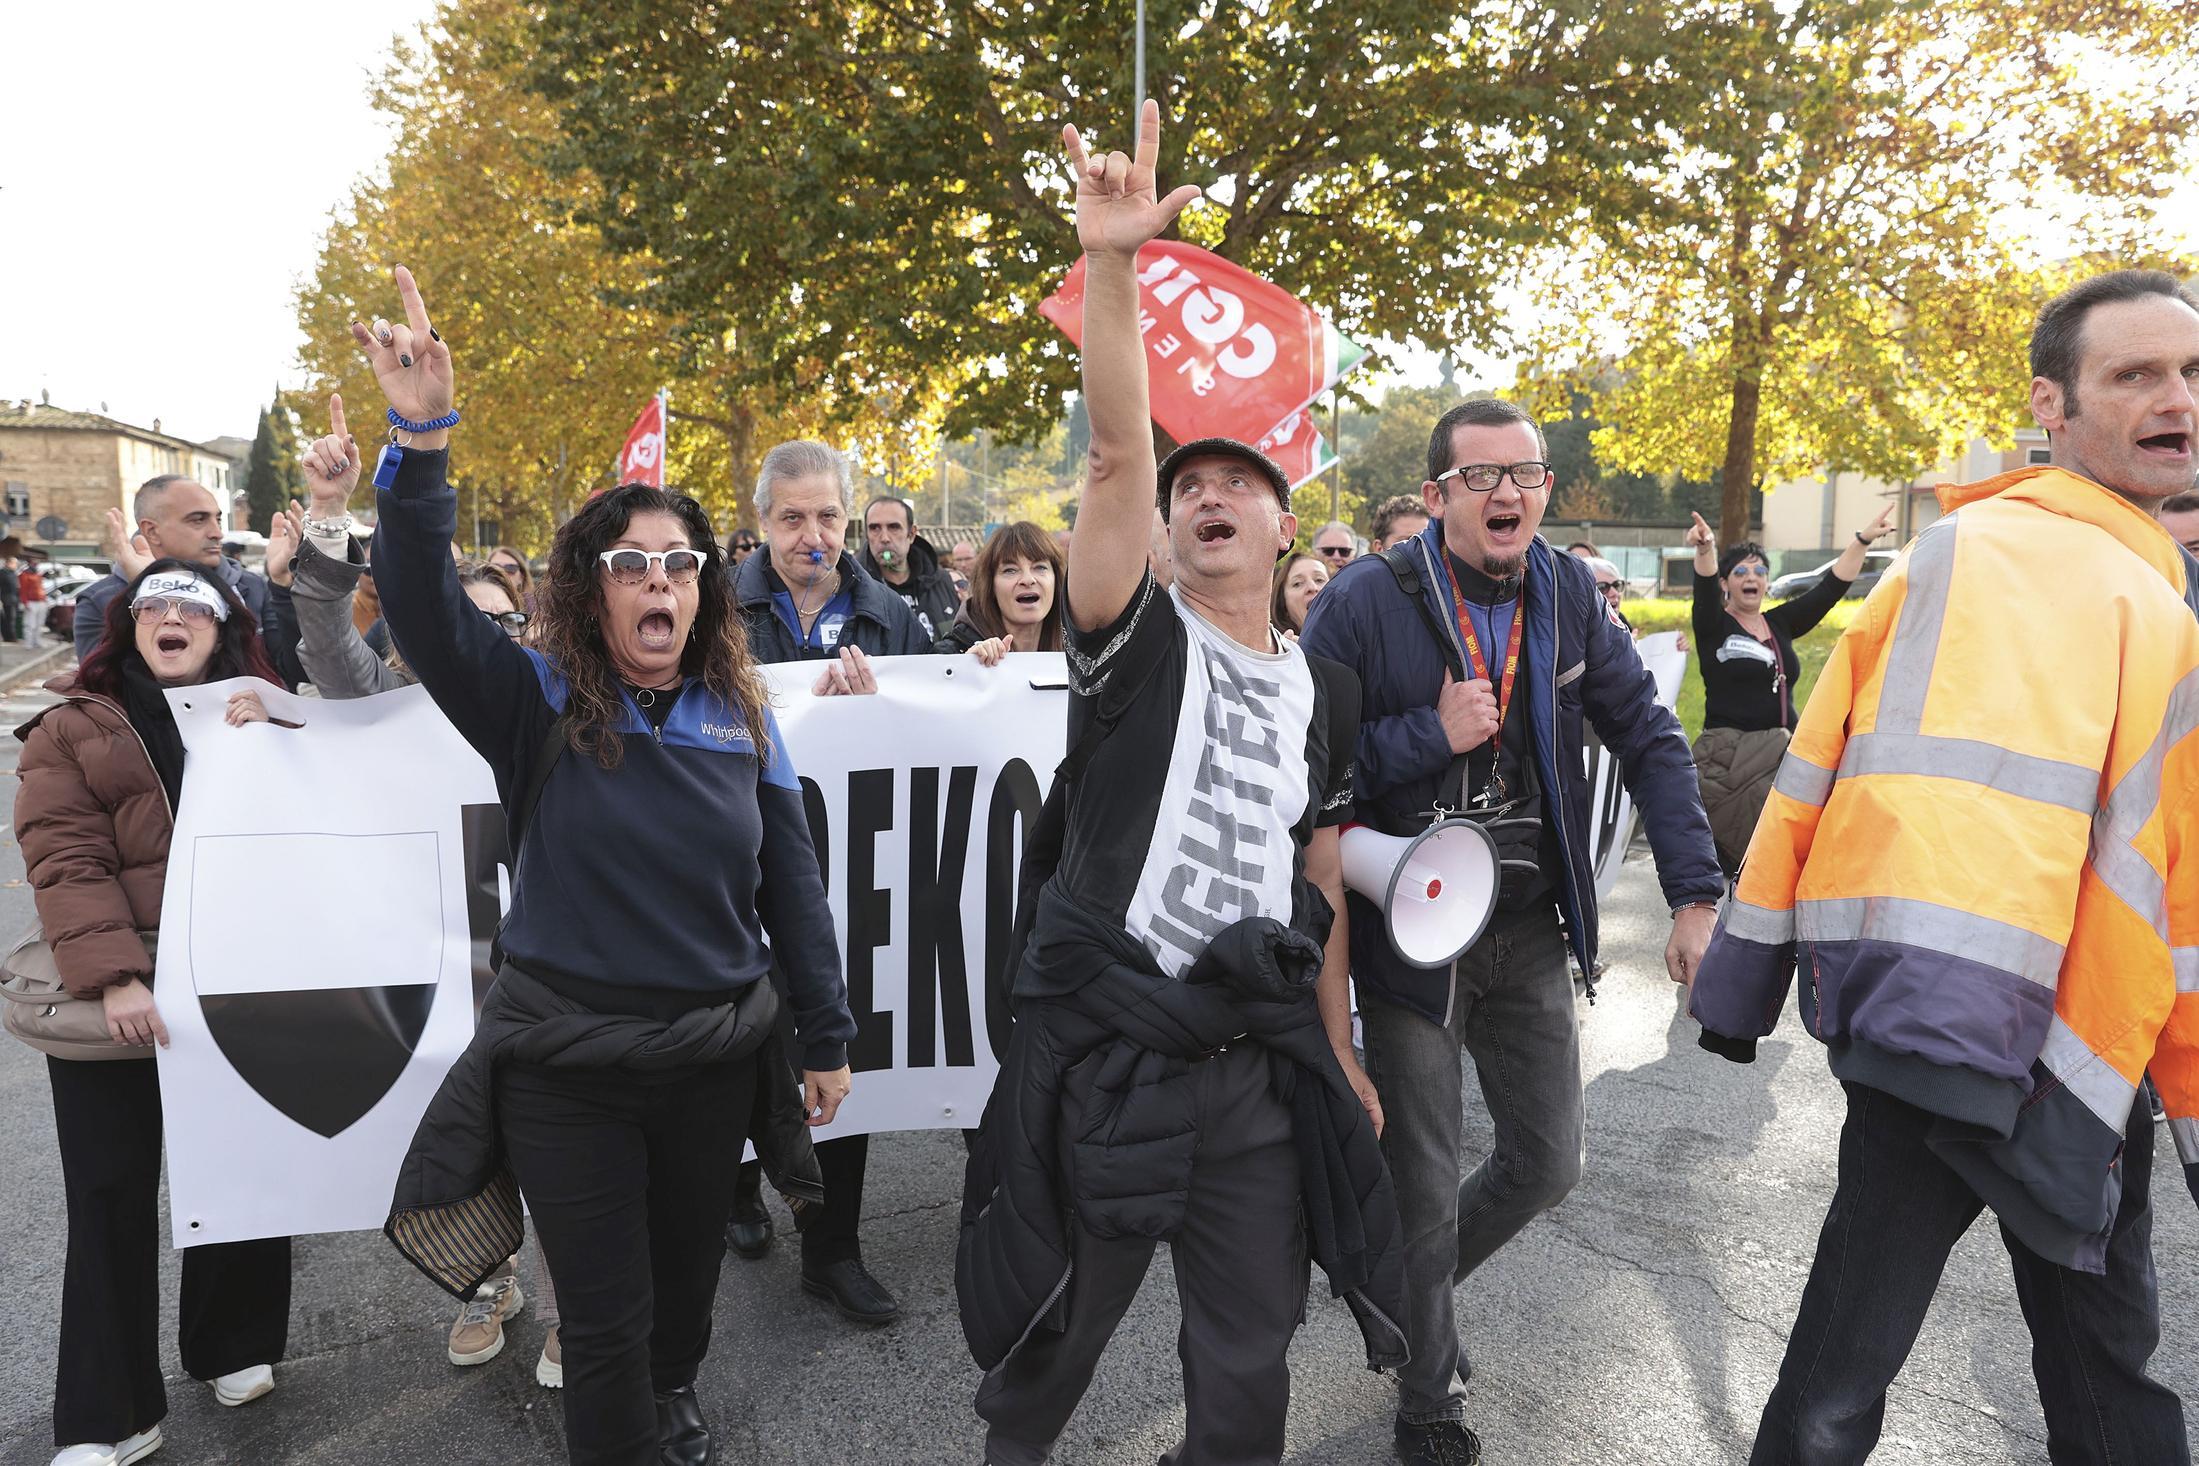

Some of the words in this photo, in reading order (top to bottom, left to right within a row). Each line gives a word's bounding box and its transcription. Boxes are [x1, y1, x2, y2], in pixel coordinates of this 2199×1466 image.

[1466, 634, 1478, 656] FIOM
[1506, 655, 1518, 675] FIOM
[790, 757, 1044, 1083] EKO
